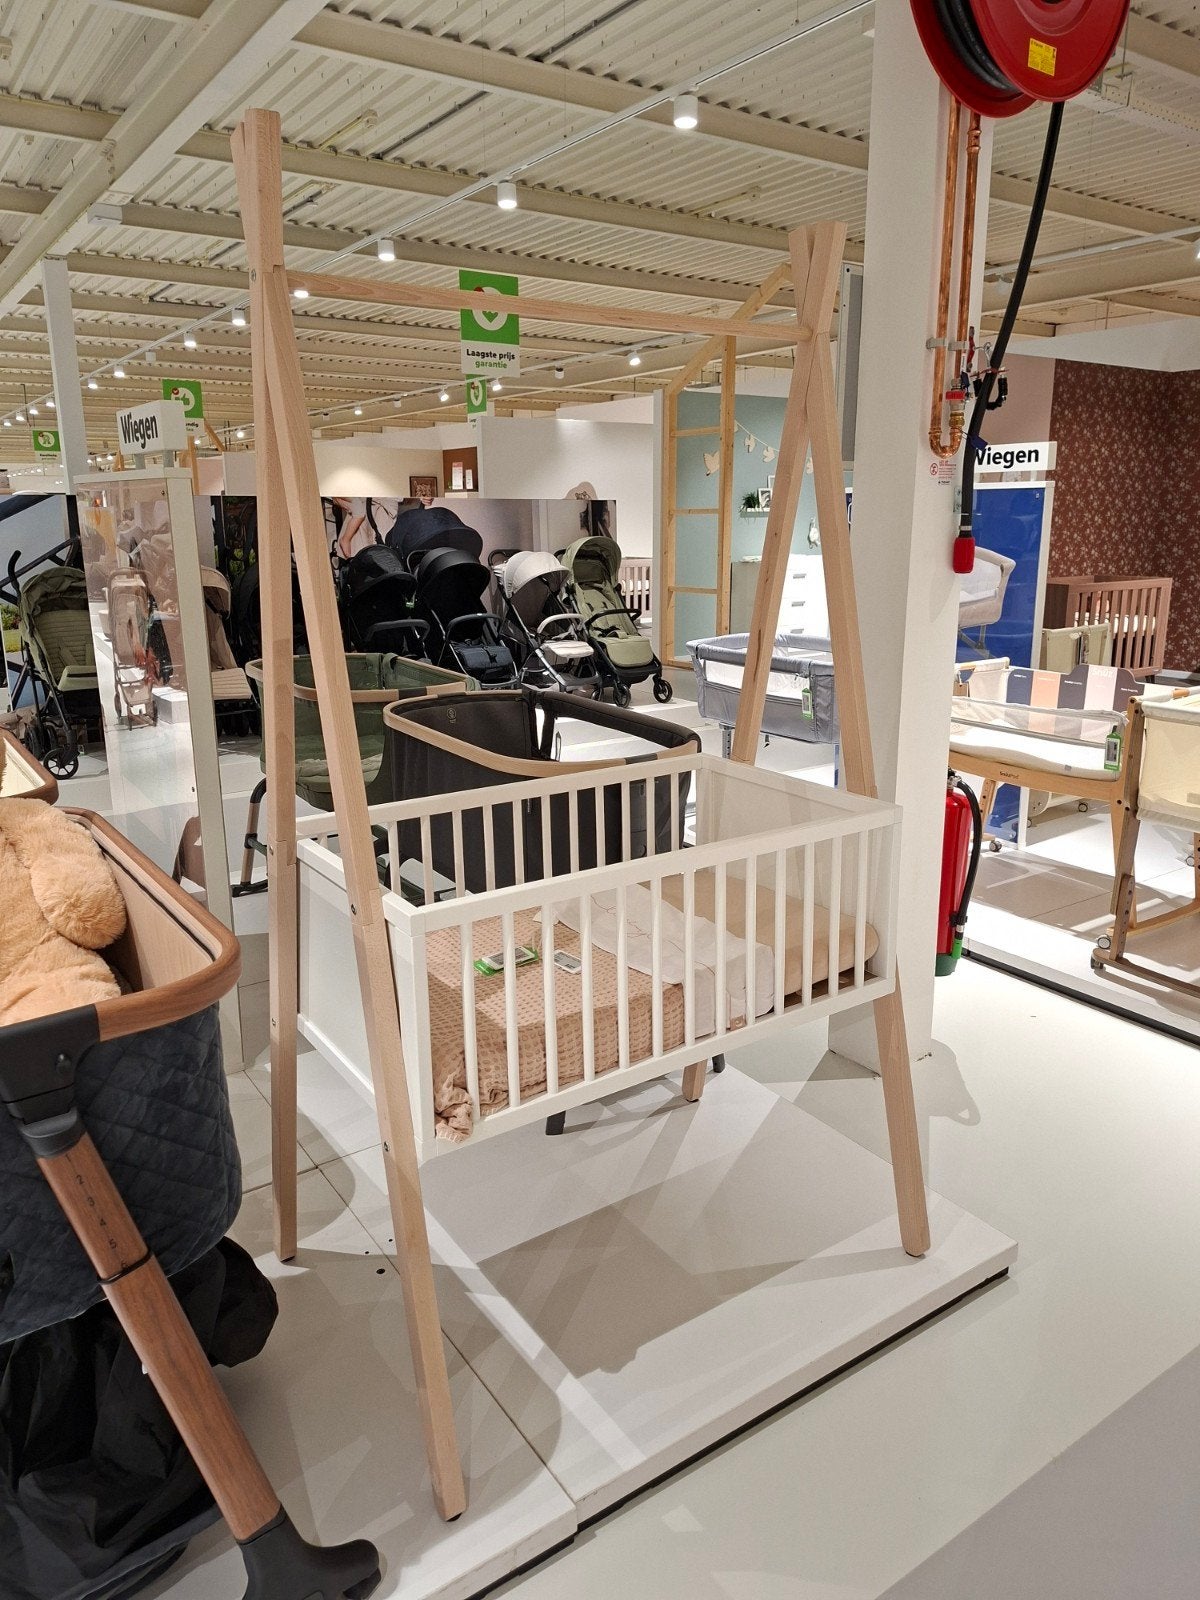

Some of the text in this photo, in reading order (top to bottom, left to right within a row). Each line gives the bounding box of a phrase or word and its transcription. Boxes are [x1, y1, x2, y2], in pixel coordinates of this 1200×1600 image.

[466, 348, 515, 361] Laagste prijs
[475, 360, 507, 369] garantie
[120, 412, 158, 449] Wiegen
[76, 1174, 84, 1185] 2
[87, 1196, 96, 1207] 3
[99, 1218, 107, 1227] 4
[109, 1238, 117, 1250] 5
